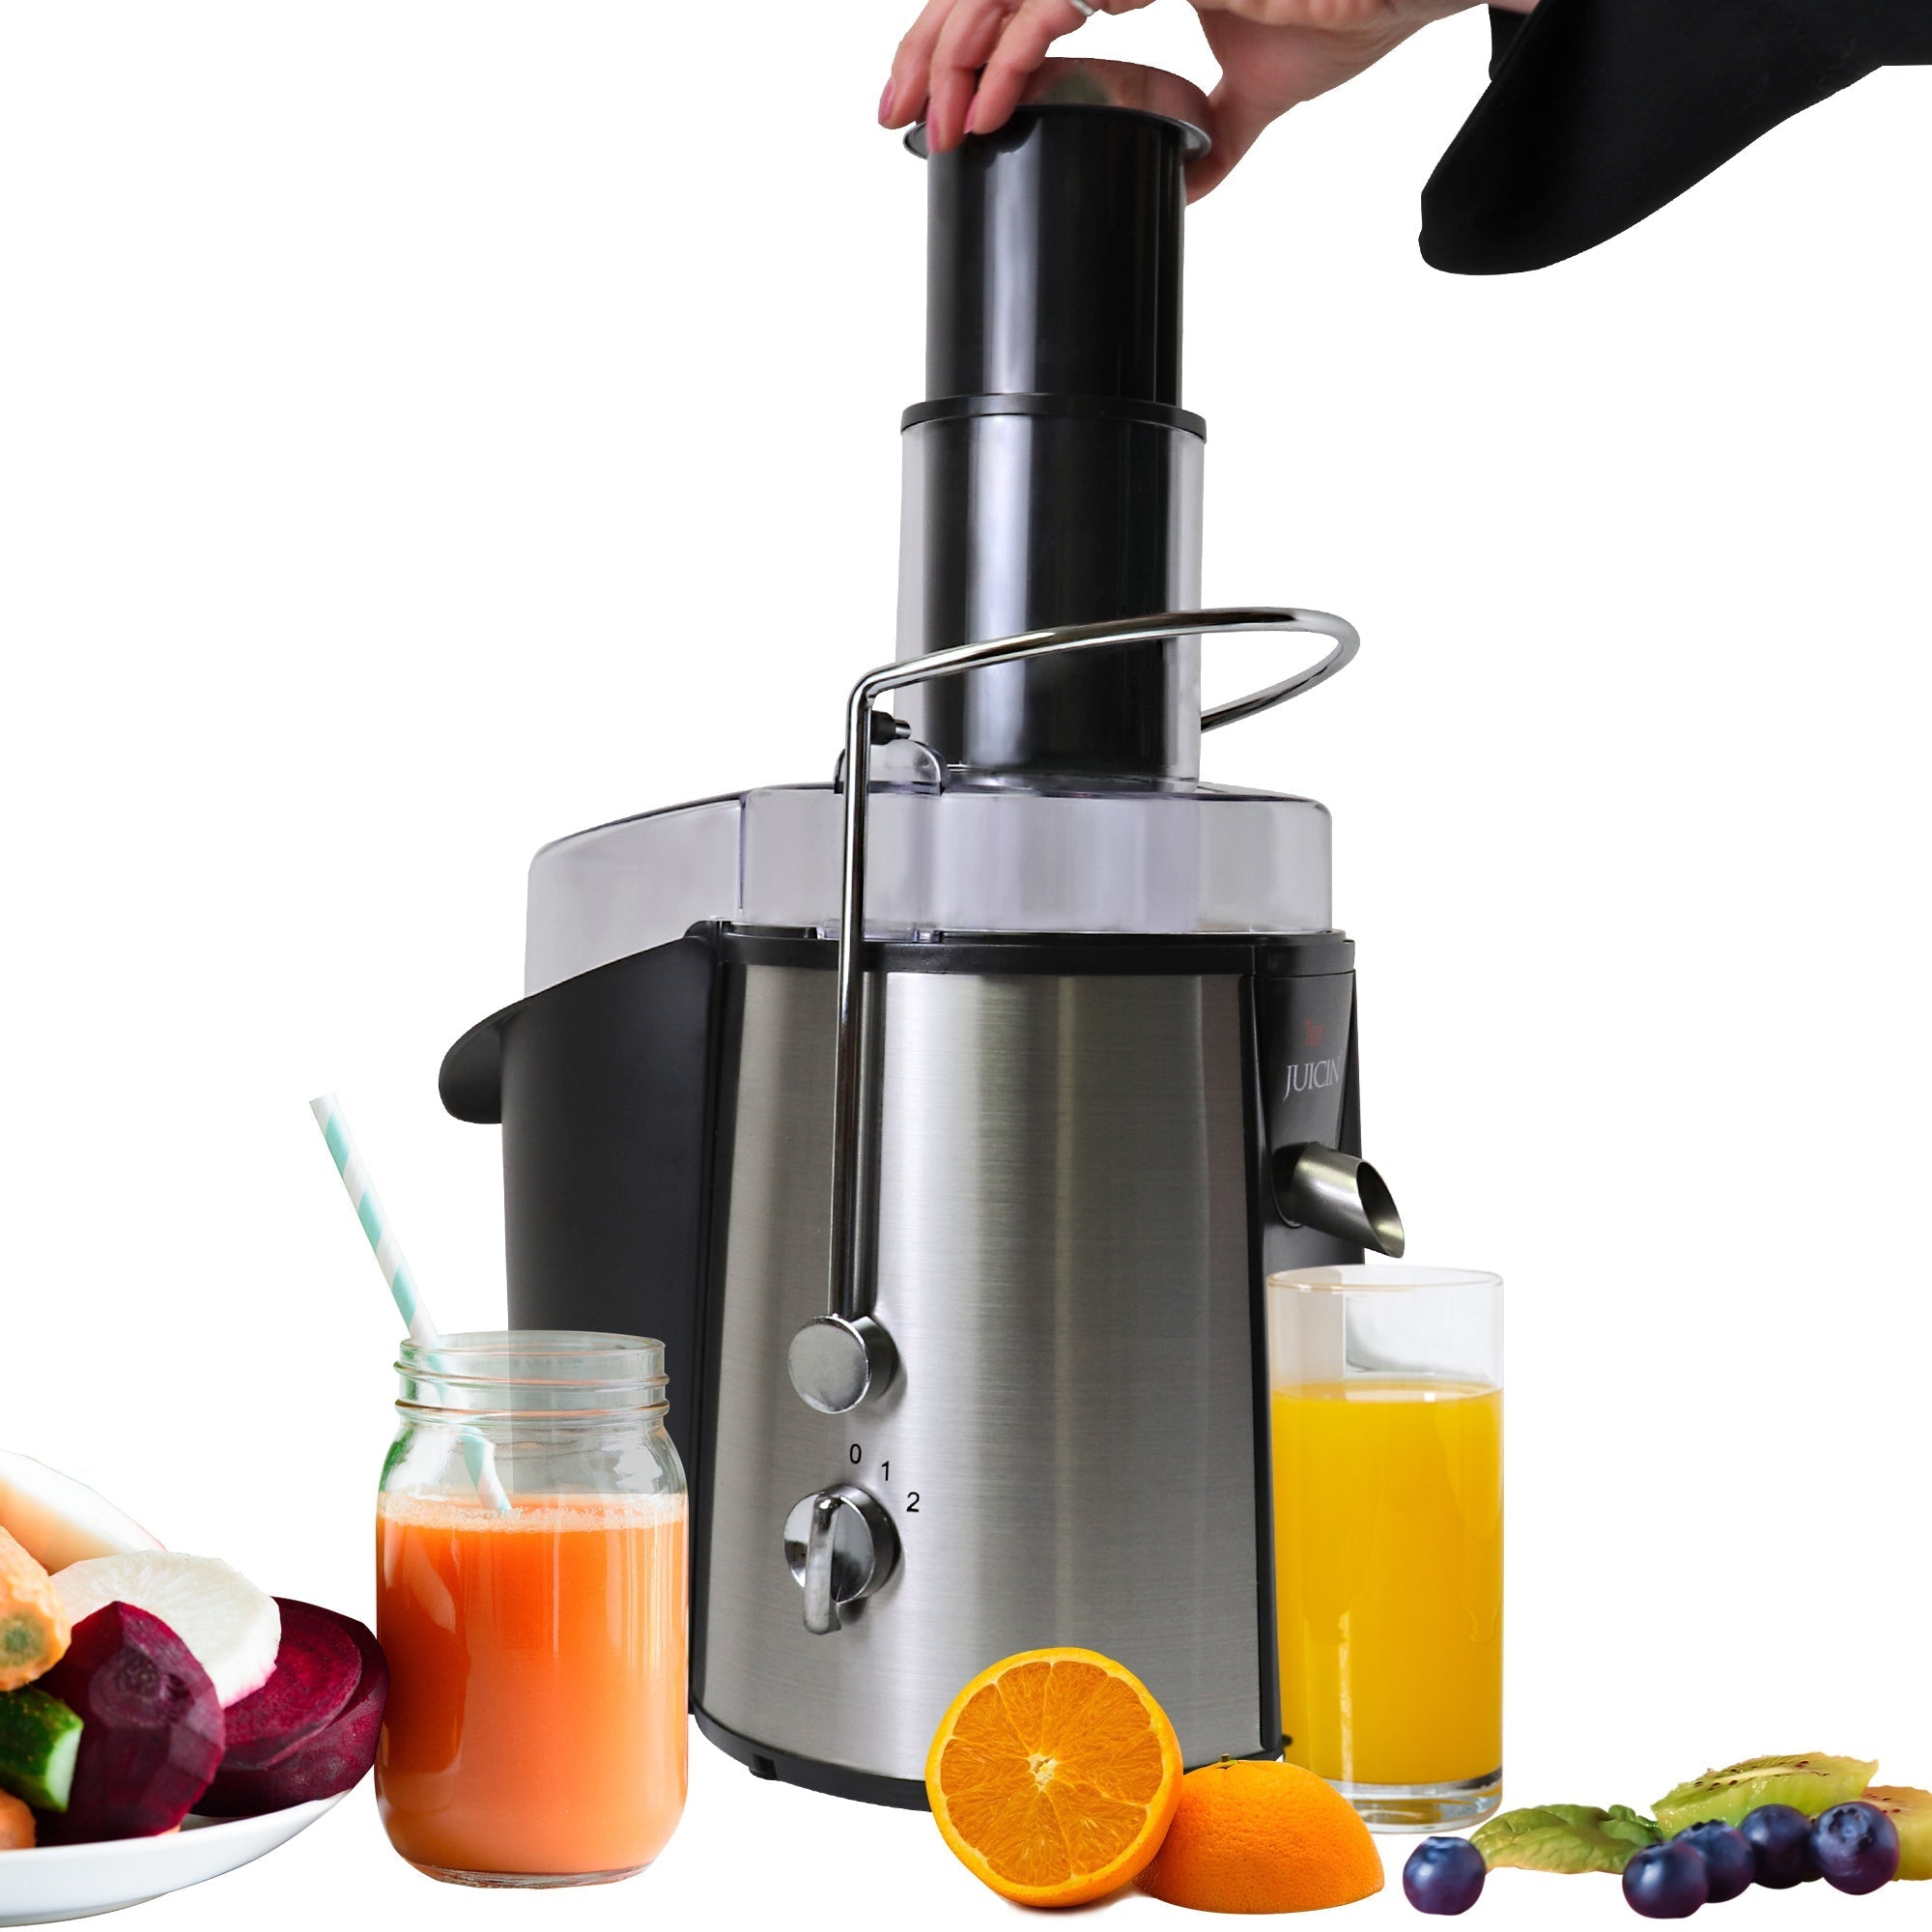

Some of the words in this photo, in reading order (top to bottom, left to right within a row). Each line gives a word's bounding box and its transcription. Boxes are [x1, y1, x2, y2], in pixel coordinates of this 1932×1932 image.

[850, 1443, 862, 1464] 0
[881, 1461, 890, 1482] 1
[906, 1492, 920, 1513] 2
